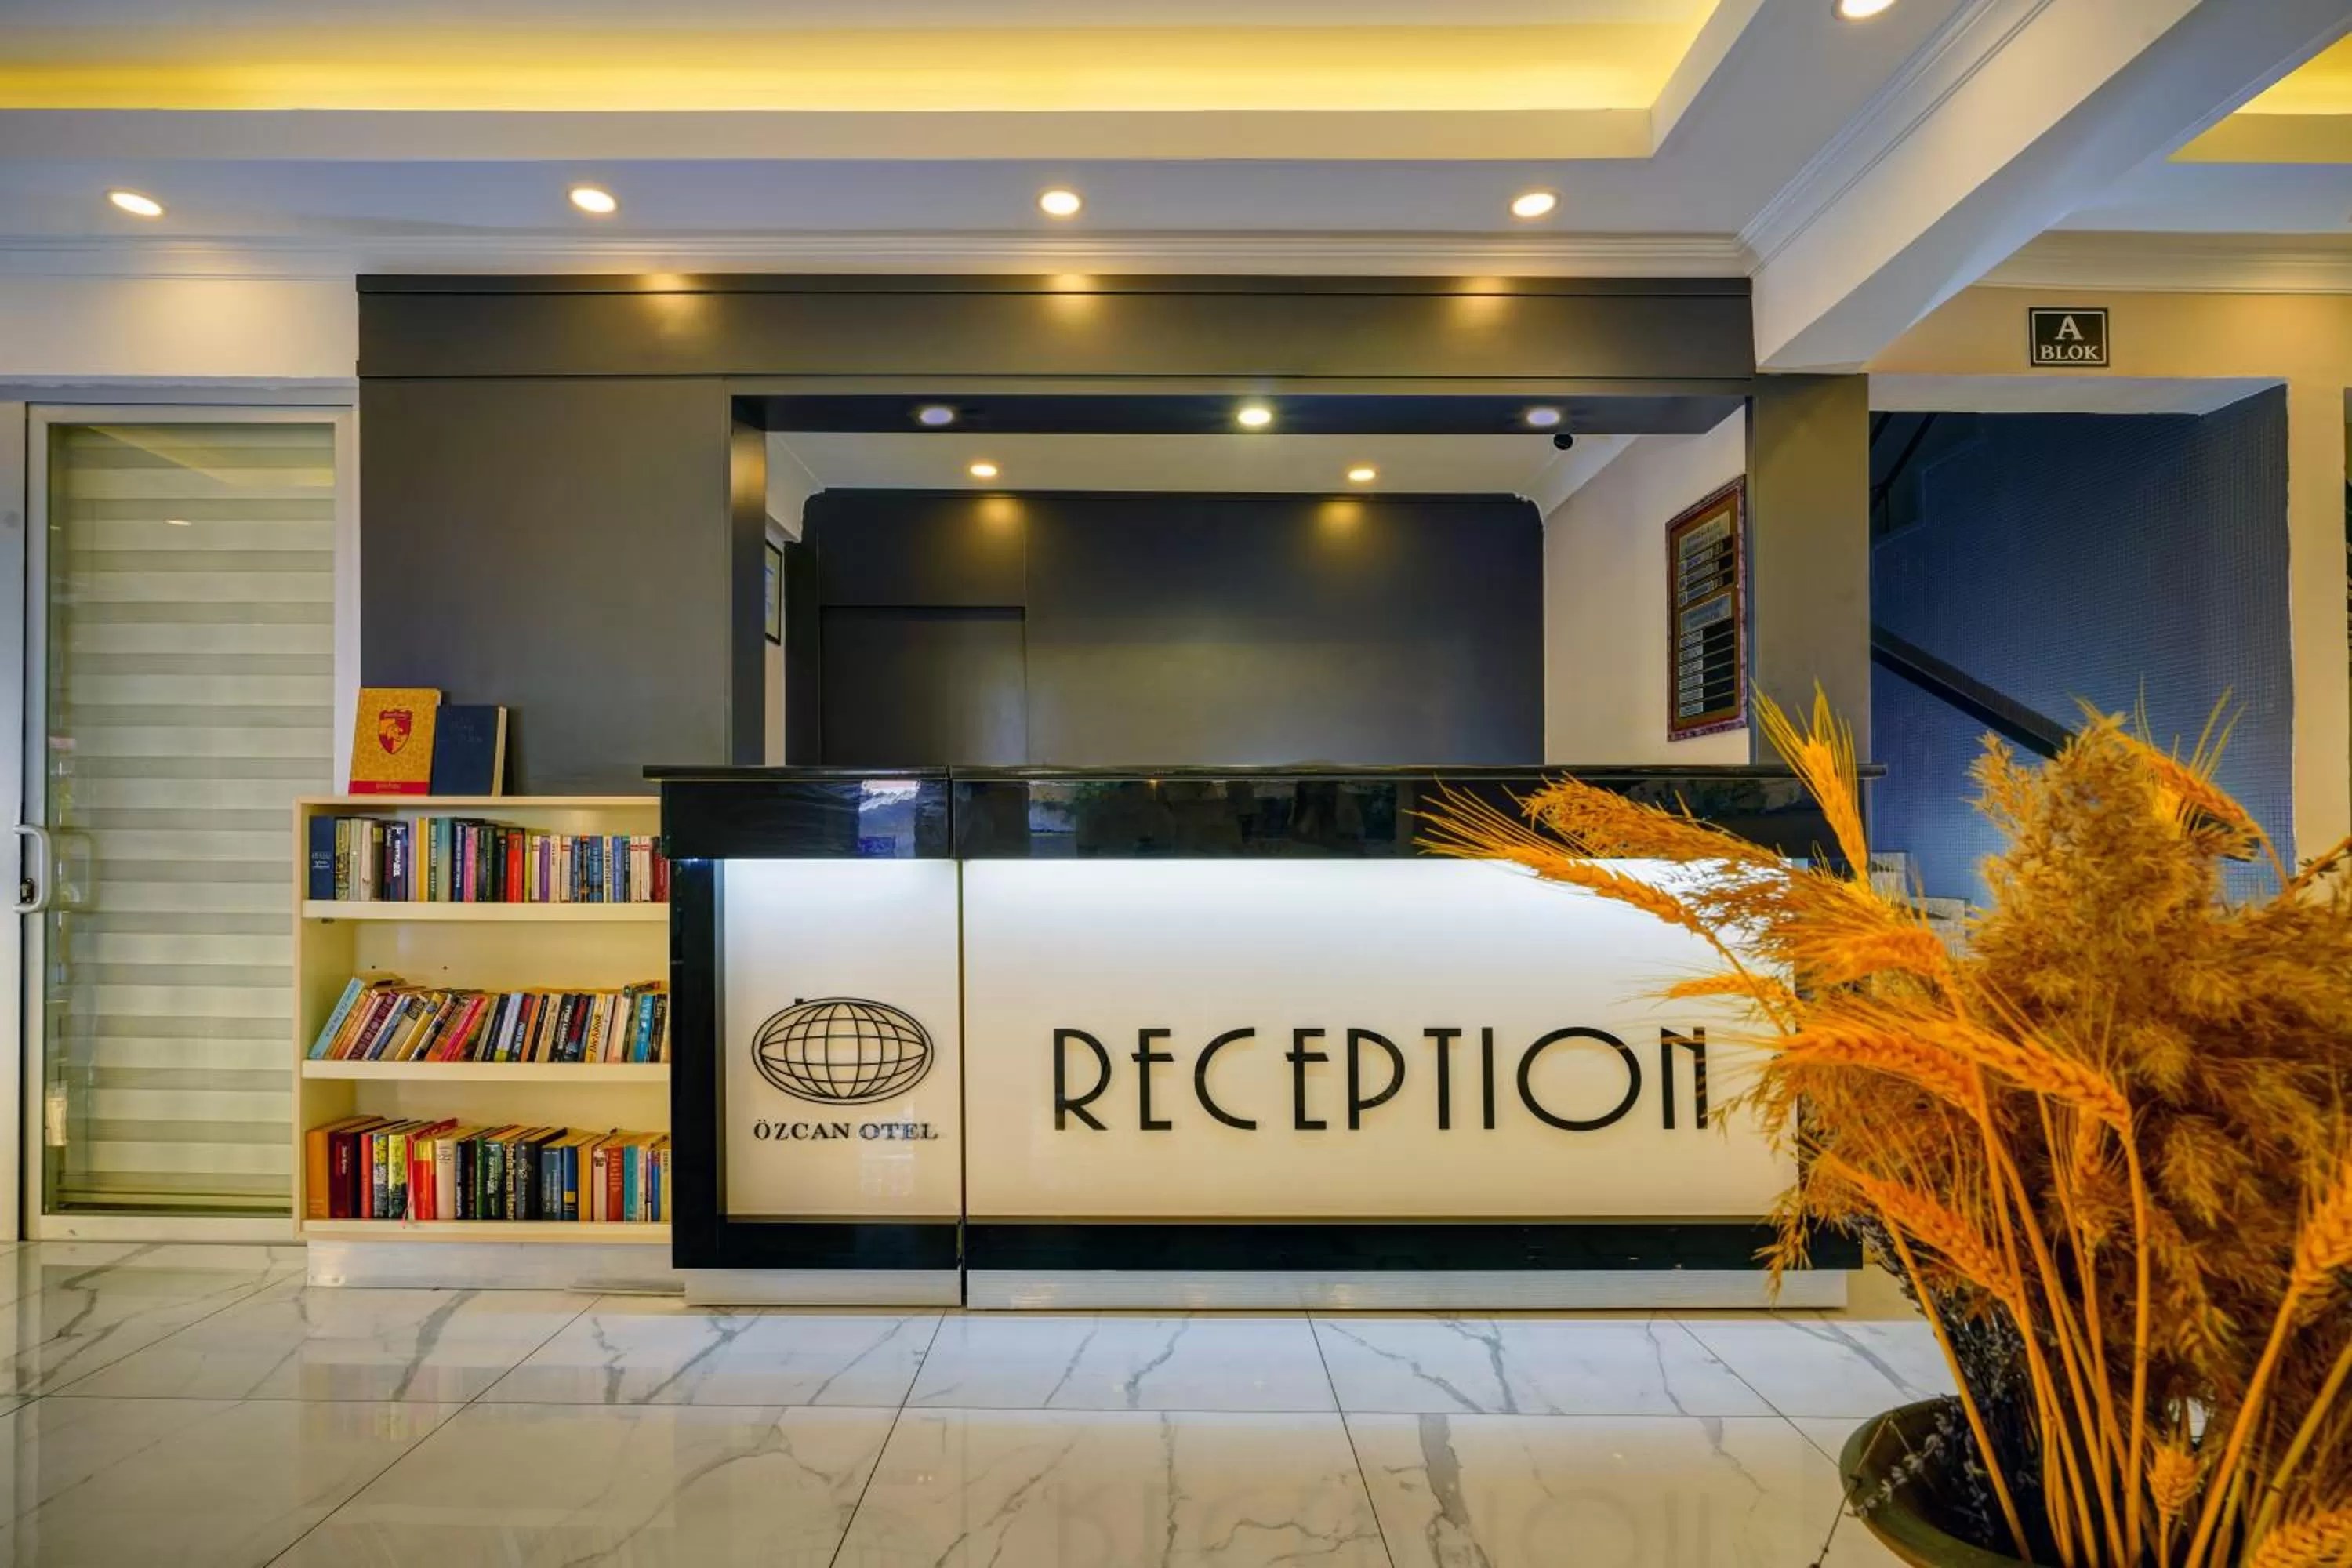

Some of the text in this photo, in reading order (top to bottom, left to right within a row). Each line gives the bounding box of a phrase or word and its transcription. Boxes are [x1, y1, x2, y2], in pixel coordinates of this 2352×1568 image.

[2054, 315, 2085, 340] A
[2039, 345, 2100, 360] BLOK
[1054, 1026, 1708, 1131] RECEPTION
[753, 1119, 938, 1140] ÖZCAN OTEL
